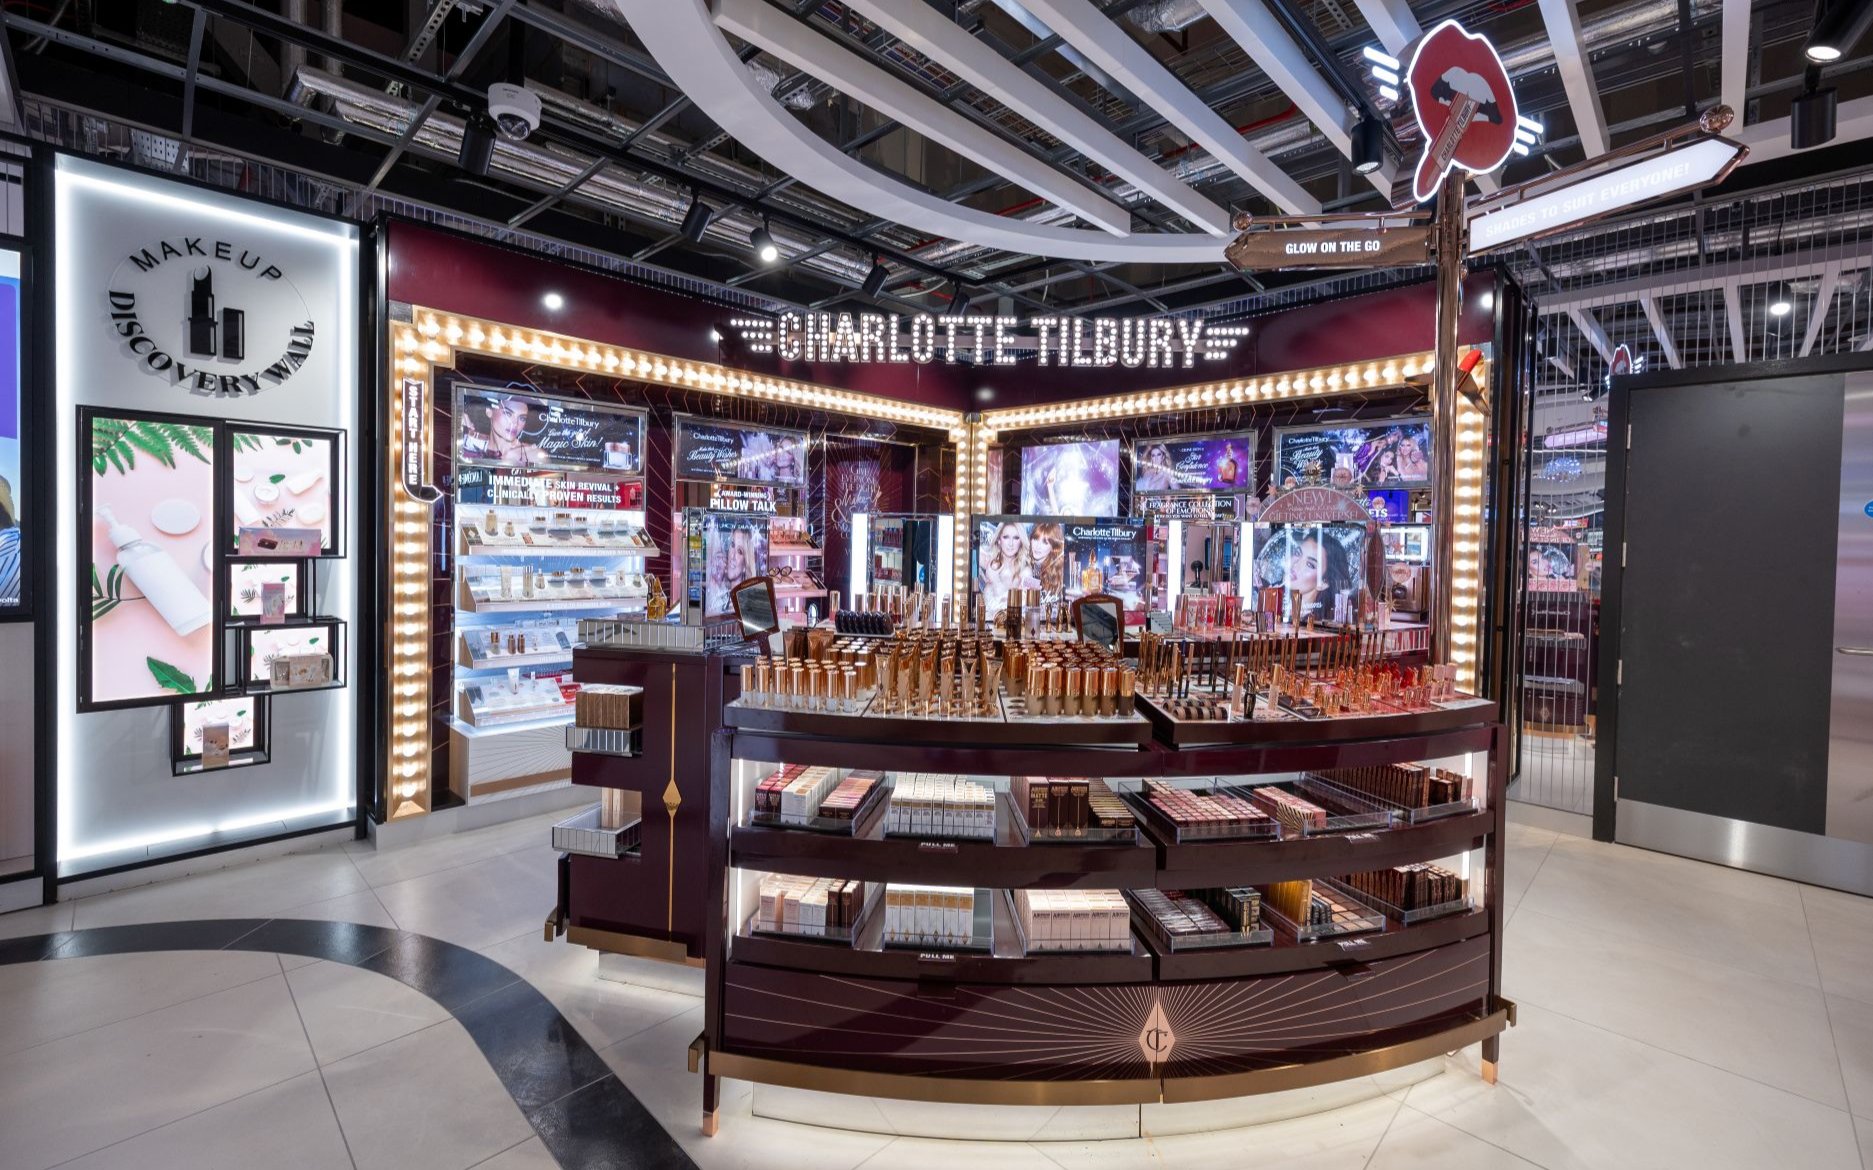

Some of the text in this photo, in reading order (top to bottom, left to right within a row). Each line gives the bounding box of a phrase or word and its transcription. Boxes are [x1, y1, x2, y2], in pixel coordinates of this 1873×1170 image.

[1441, 127, 1461, 161] CHARLOTTE
[1485, 162, 1690, 238] SHADES TO SUIT EVERYONE!
[129, 237, 282, 280] MAKEUP
[1285, 240, 1381, 254] GLOW ON THE GO
[109, 290, 315, 393] DISCOVERY WALL
[777, 311, 1205, 369] CHARLOTTE TILBURY
[408, 385, 419, 485] START HERE
[488, 474, 553, 489] IMMEDIATE
[555, 480, 577, 490] SKIN
[578, 481, 612, 492] REVIVAL
[543, 490, 584, 503] PROVEN
[586, 493, 622, 504] RESULTS
[710, 498, 776, 512] PILLOW TALK
[1149, 500, 1232, 509] FRAGRANCE COLLECTION
